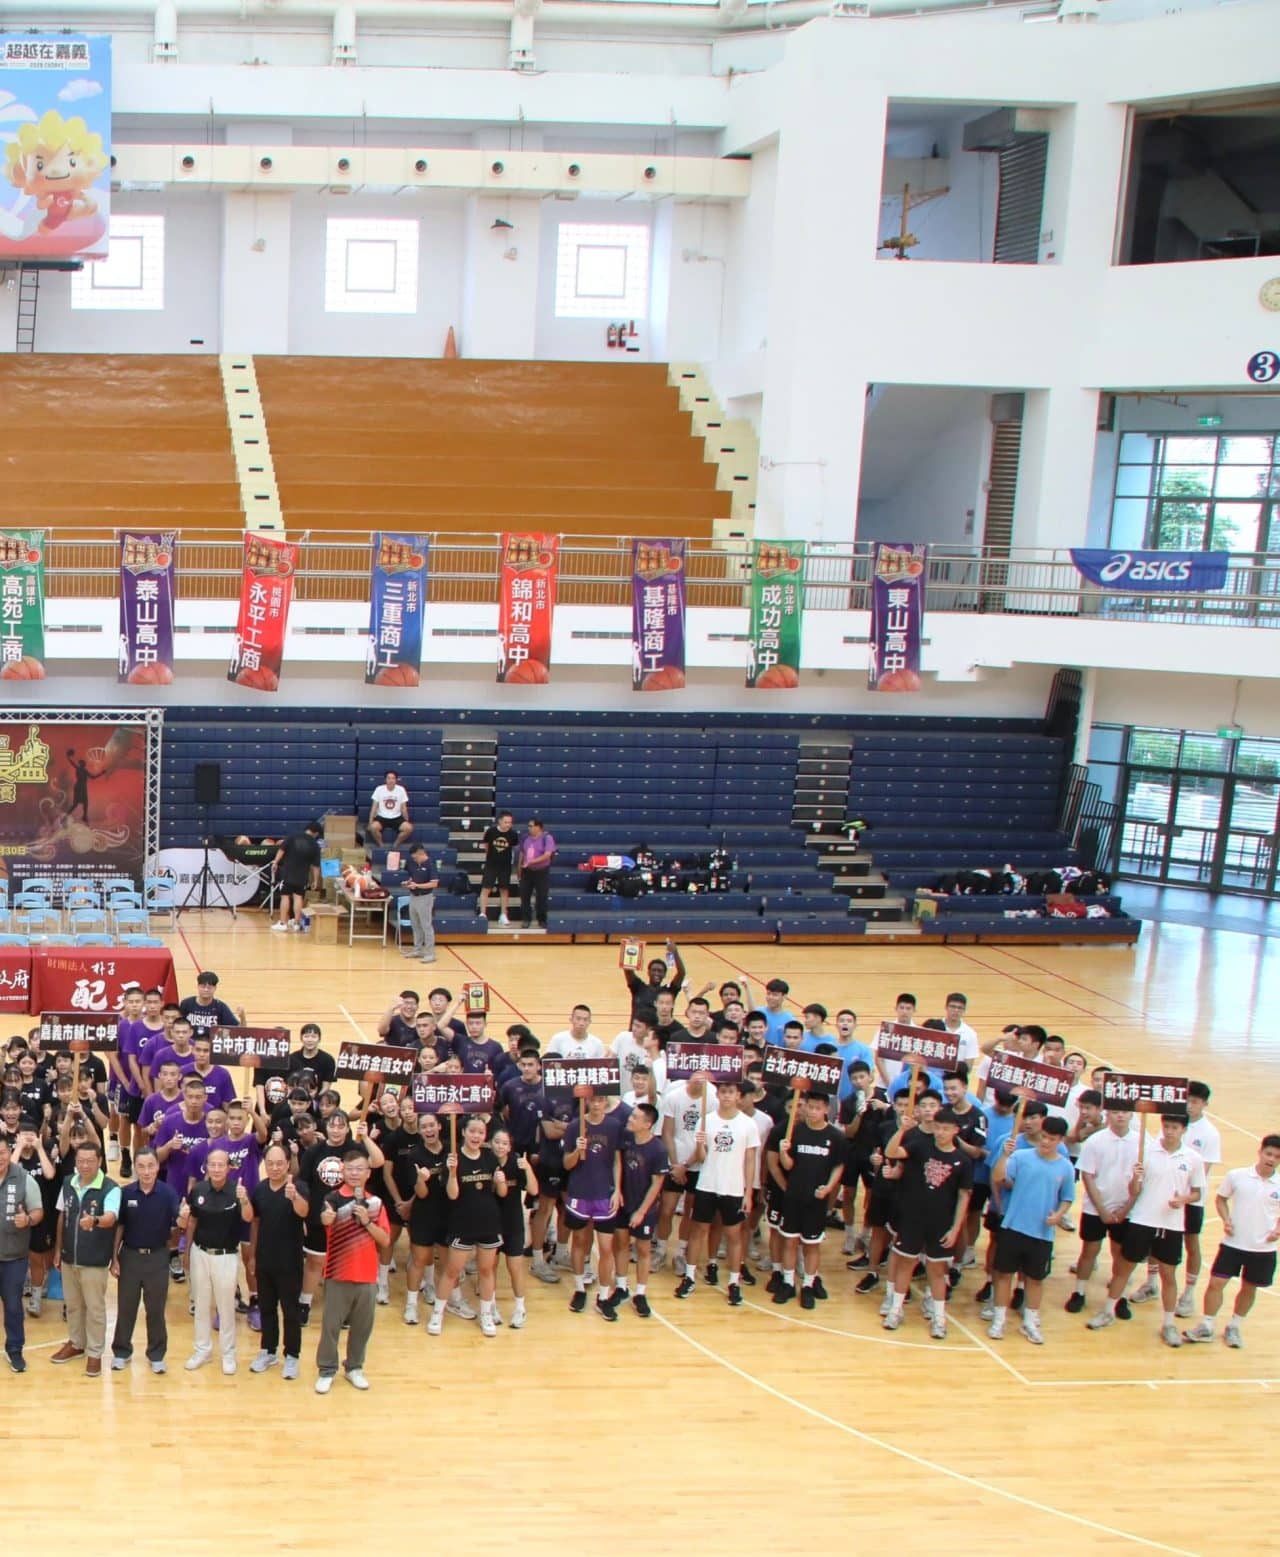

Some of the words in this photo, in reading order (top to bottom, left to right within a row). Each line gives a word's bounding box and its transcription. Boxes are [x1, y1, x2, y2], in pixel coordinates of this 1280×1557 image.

[1253, 353, 1272, 380] 3
[1129, 560, 1192, 580] asics
[406, 580, 417, 613] 新北市
[535, 579, 546, 610] 新北市
[784, 584, 795, 616] 台北市
[1, 575, 24, 663] 高苑工商
[135, 579, 158, 667] 泰山高中
[240, 583, 268, 672] 永平工商
[378, 581, 404, 669] 三重商工
[508, 578, 534, 666] 錦和高中
[643, 587, 666, 673] 基隆商工
[758, 584, 782, 671] 成功高中
[883, 589, 908, 674] 東山高中
[40, 1023, 118, 1042] 嘉義市輔仁中學
[212, 1036, 289, 1058] 台中市東山高中
[878, 1032, 957, 1060] 新竹縣東泰高中
[545, 1067, 620, 1087] 基隆市基隆商工
[668, 1052, 742, 1073] 新北市泰山高中
[765, 1054, 840, 1085] 台北市成功高中
[415, 1086, 492, 1104] 台南市永仁高中
[1104, 1081, 1187, 1103] 新北市三重商工
